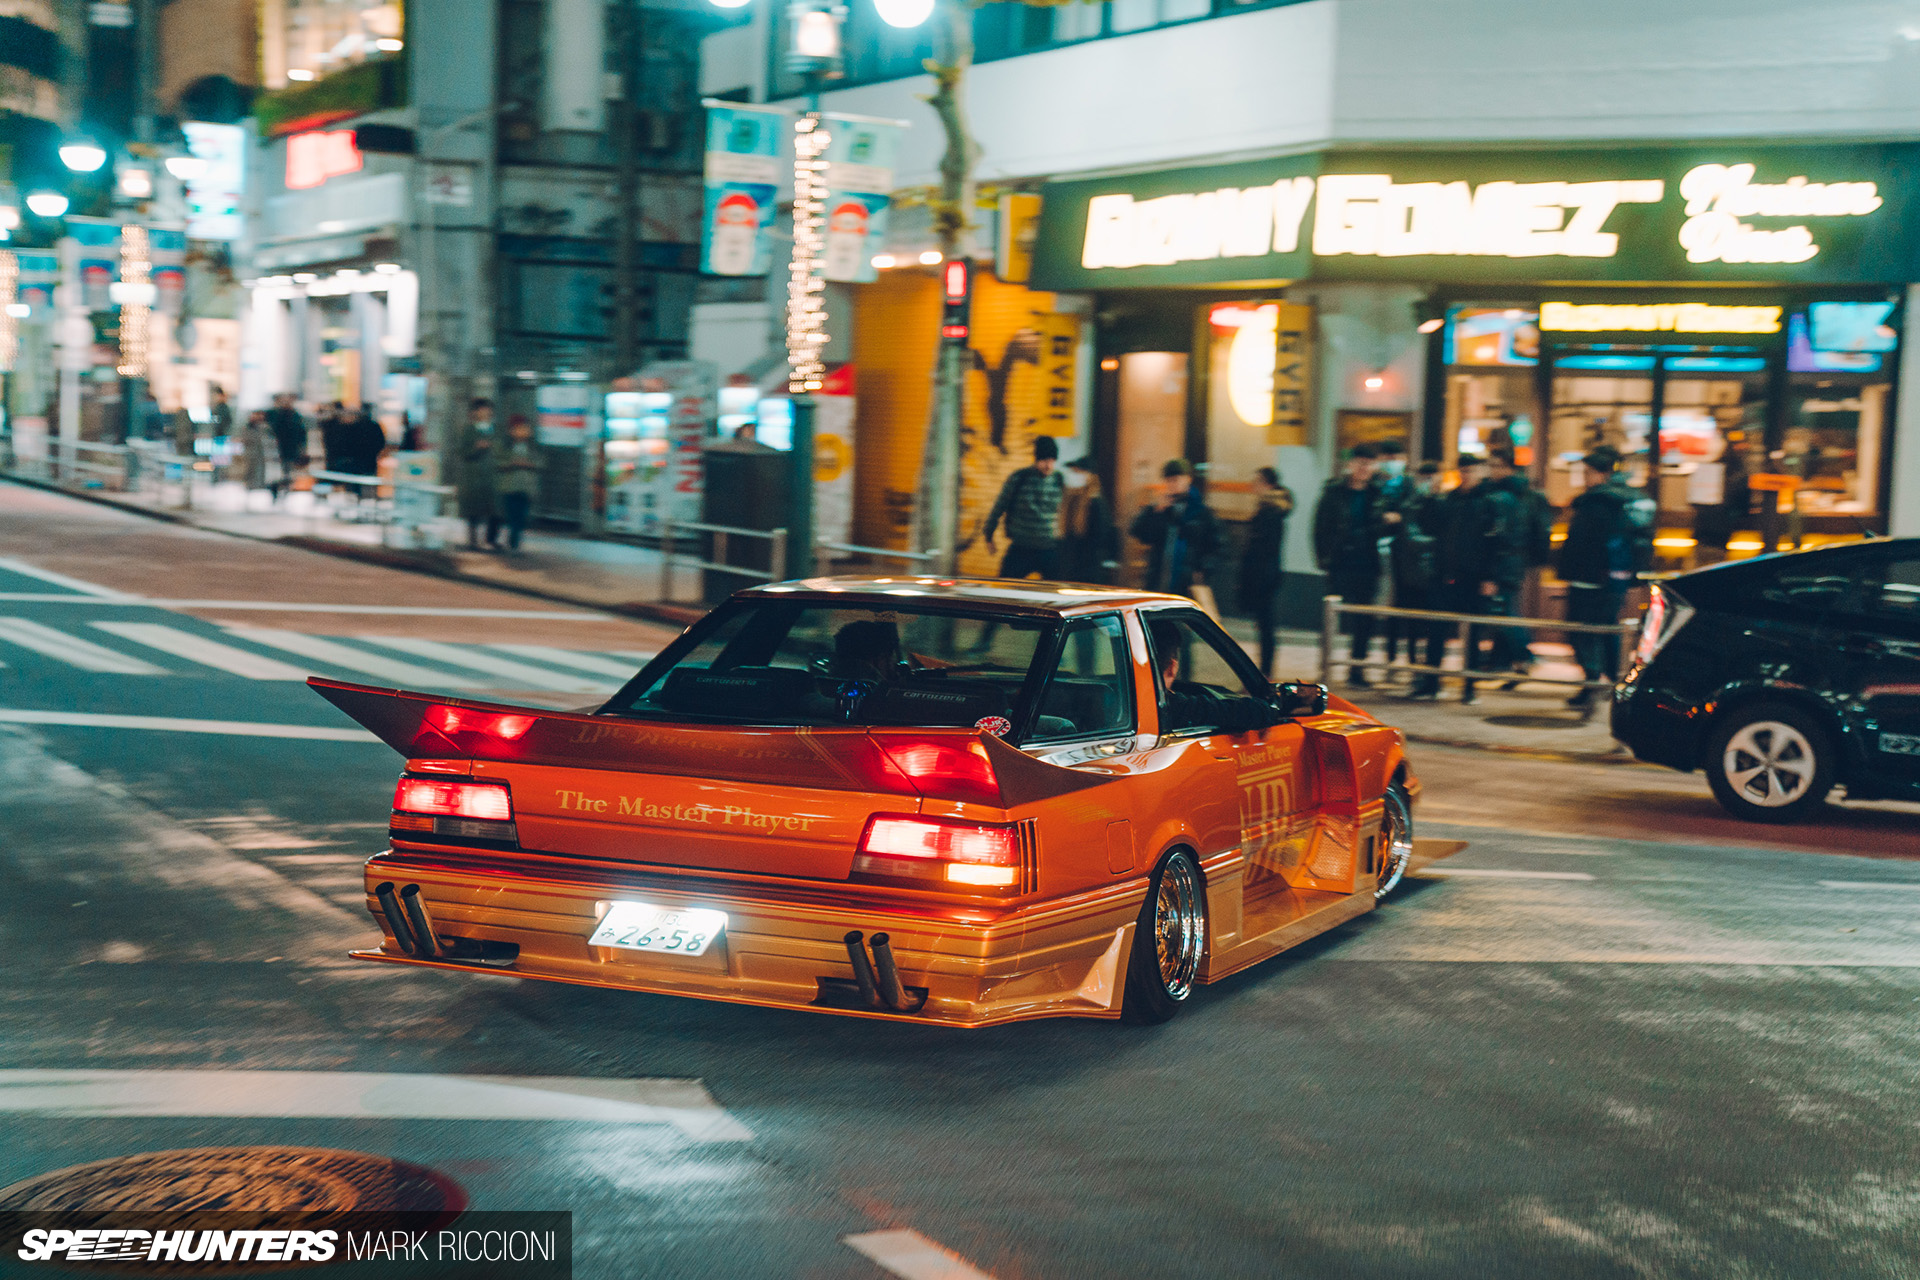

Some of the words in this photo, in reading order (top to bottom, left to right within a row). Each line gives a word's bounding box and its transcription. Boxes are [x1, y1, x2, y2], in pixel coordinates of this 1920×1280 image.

[1313, 174, 1663, 257] GOMEZ
[555, 789, 609, 813] The
[617, 795, 713, 823] Master
[722, 804, 814, 835] Player
